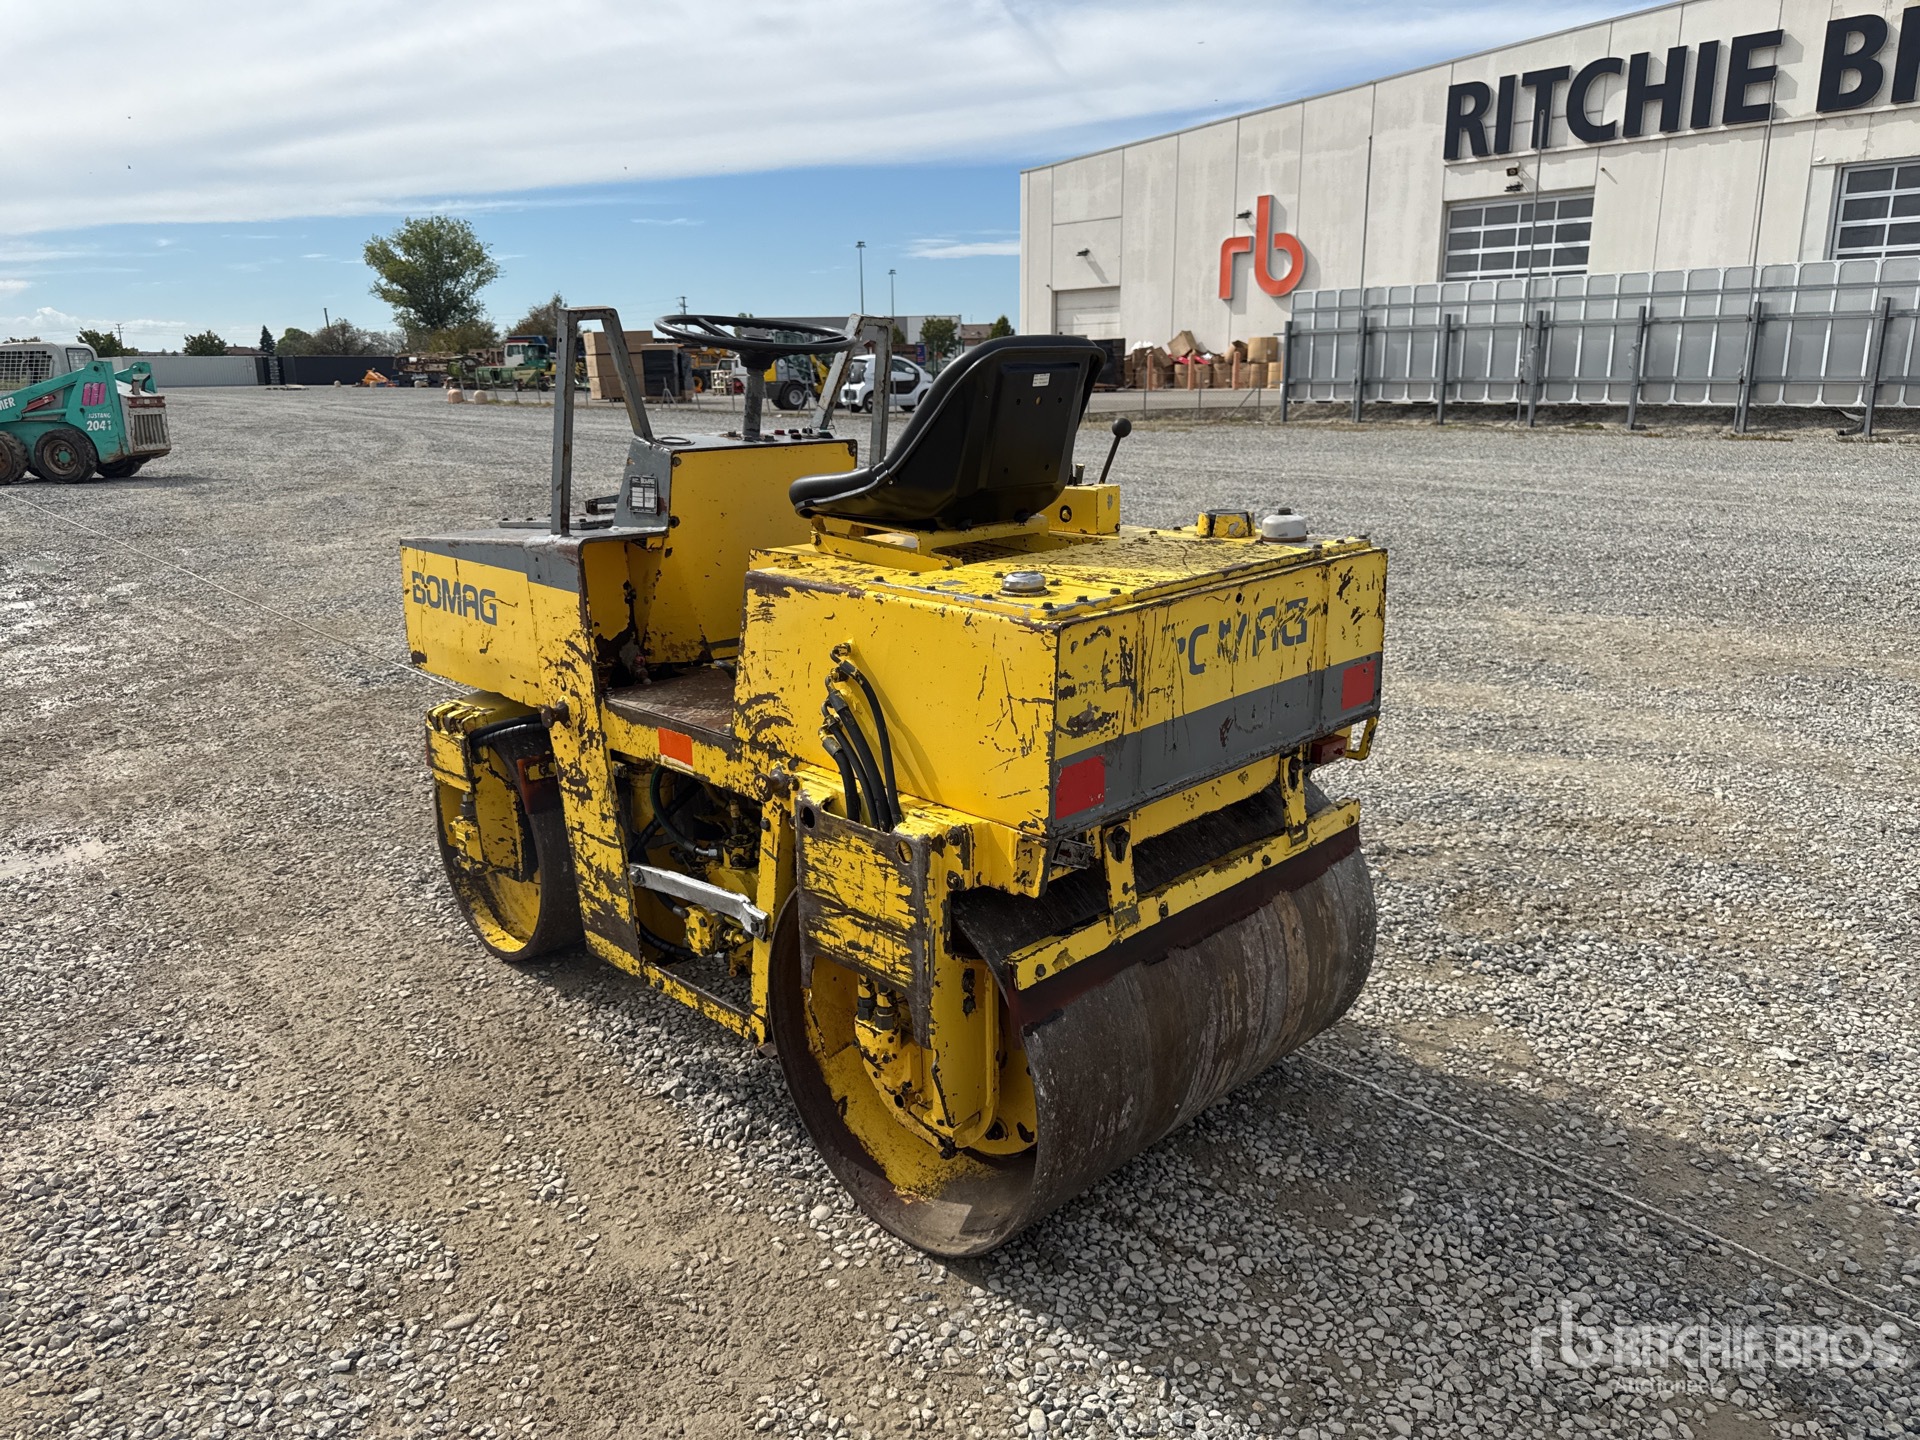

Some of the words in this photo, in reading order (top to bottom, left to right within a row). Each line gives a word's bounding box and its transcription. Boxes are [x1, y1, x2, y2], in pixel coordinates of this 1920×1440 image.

[1443, 29, 1785, 161] RITCHIE
[1219, 195, 1306, 300] rb
[86, 420, 106, 431] 204
[412, 570, 497, 626] BOMAG
